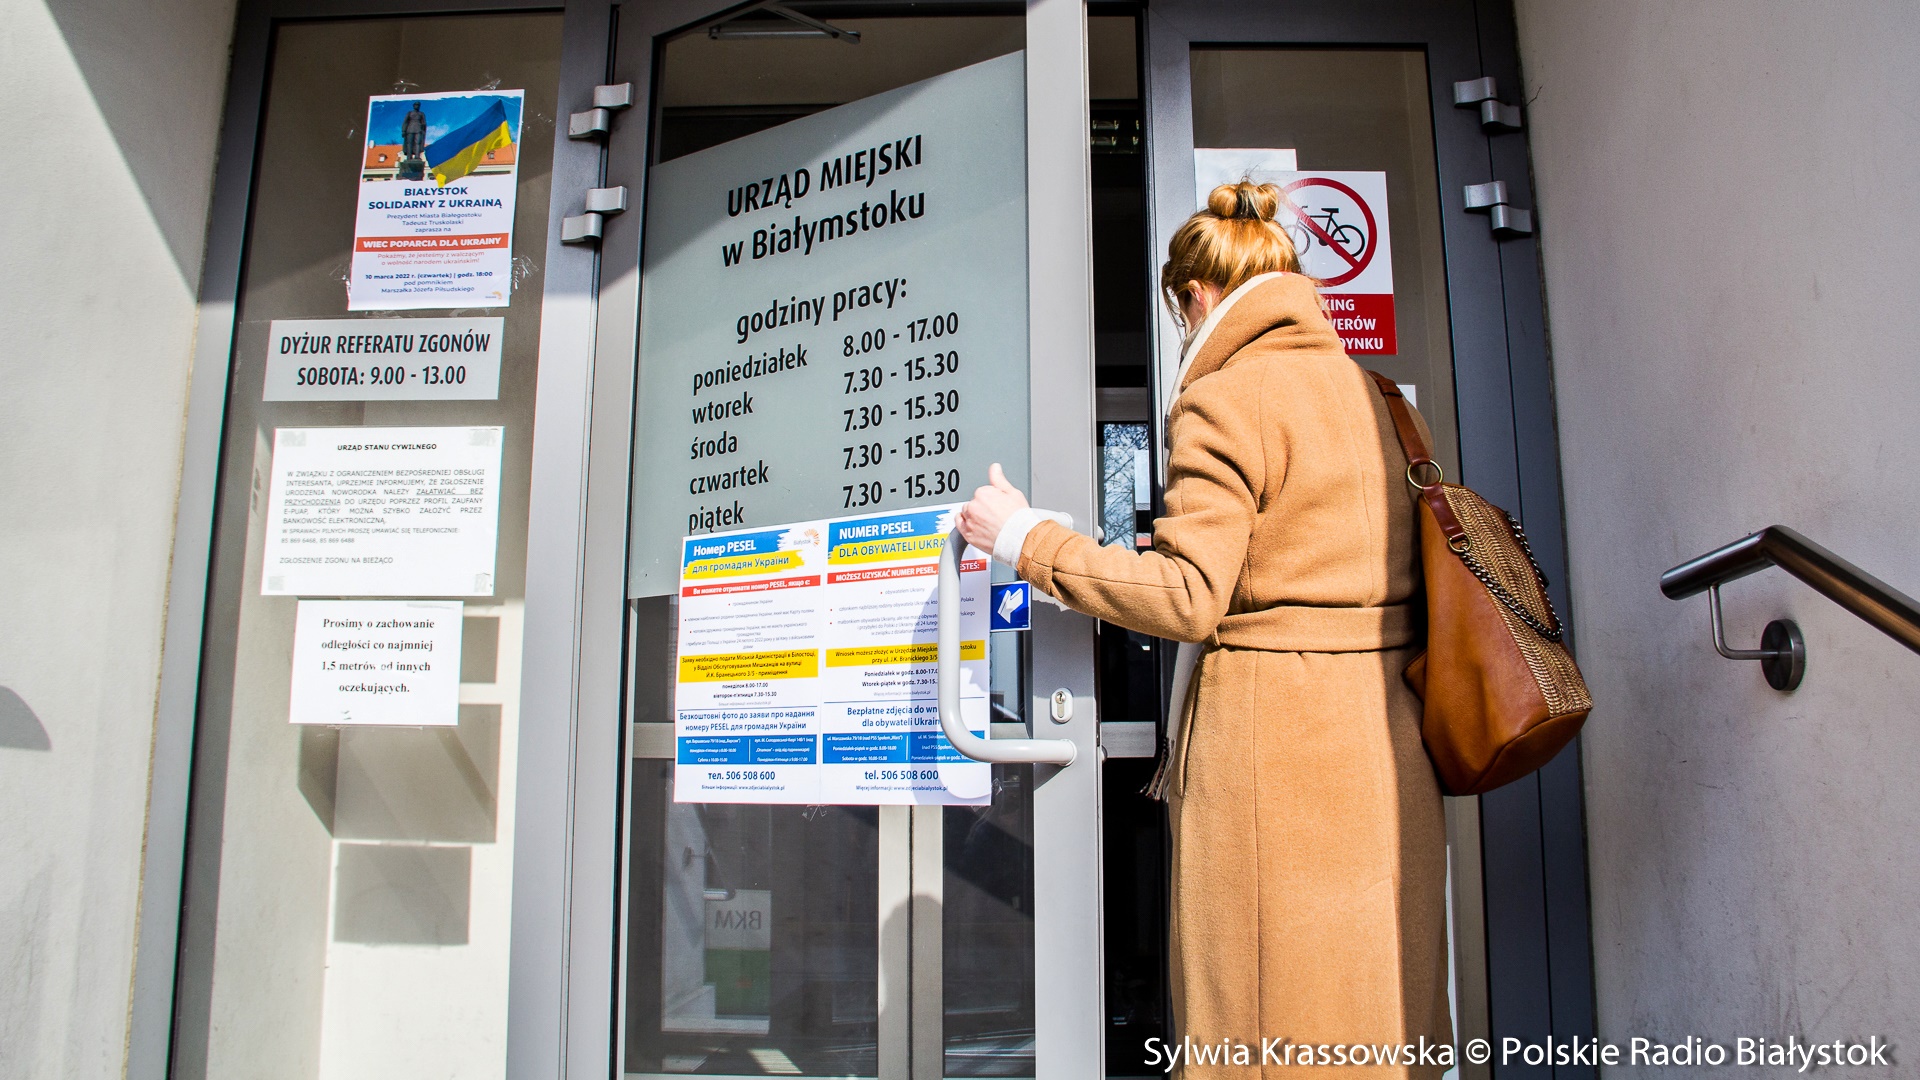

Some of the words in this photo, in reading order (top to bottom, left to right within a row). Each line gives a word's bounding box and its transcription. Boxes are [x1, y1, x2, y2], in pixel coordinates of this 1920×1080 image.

[727, 167, 810, 218] URZĄD
[820, 134, 923, 191] MIEJSKI
[404, 187, 468, 196] BIAŁYSTOK
[369, 200, 435, 209] SOLIDARNY
[449, 199, 502, 209] UKRAINĄ
[722, 239, 743, 267] w
[752, 189, 926, 261] Białymstoku
[390, 239, 436, 247] POPARCIA
[460, 237, 501, 245] UKRAINY
[736, 296, 826, 344] godziny
[833, 276, 907, 321] pracy:
[1321, 299, 1355, 311] KING
[1337, 315, 1376, 330] ERÓW
[280, 332, 331, 354] DYŻUR
[337, 335, 413, 354] REFERATU
[419, 329, 490, 353] ZGONÓW
[1346, 337, 1383, 350] YNKU
[693, 345, 808, 395] poniedziałek
[843, 329, 886, 358] 8.00
[907, 311, 960, 343] 17.00
[297, 367, 365, 386] SOBOTA:
[371, 366, 405, 384] 9.00
[423, 365, 466, 384] 13.00
[692, 392, 753, 424] wtorek
[844, 367, 883, 394] 7.30
[905, 350, 960, 382] 15.30
[690, 432, 738, 460] środa
[844, 405, 883, 432] 7.30
[905, 389, 960, 420] 15.30
[689, 460, 769, 495] czwartek
[843, 442, 882, 471] 7.30
[905, 428, 960, 460] 15.30
[296, 470, 327, 478] ZWIĄZKU
[396, 468, 451, 476] BEZPOŚREDNIEJ
[376, 479, 425, 487] INFORMUJEMY,
[428, 477, 437, 485] ŻE
[384, 487, 409, 495] NALEŻY
[416, 487, 456, 495] ZAŁATWIAĆ
[358, 498, 386, 506] URZĘDU
[688, 502, 744, 535] piątek
[842, 482, 882, 509] 7.30
[904, 469, 961, 499] 15.30
[283, 516, 326, 524] BANKOWOŚĆ
[840, 525, 879, 539] NUMER
[881, 521, 914, 535] PESEL
[694, 545, 725, 556] Номер
[727, 540, 756, 552] PESEL
[840, 548, 858, 558] DLA
[861, 541, 916, 556] OBYWATELI
[919, 538, 945, 551] UKRA
[363, 556, 393, 564] BIEŻĄCO
[692, 565, 708, 574] для
[710, 560, 752, 571] громадян
[755, 556, 789, 568] України
[836, 572, 861, 581] MOŻESZ
[862, 569, 890, 579] UZYSKAĆ
[891, 568, 914, 577] NUMER
[916, 566, 936, 575] PESEL,
[323, 619, 363, 630] Prosimy
[375, 619, 434, 628] zachowanie
[321, 640, 370, 650] odległości
[388, 641, 433, 651] najmniej
[339, 662, 375, 671] metrów
[381, 662, 393, 670] od
[396, 662, 431, 673] innych
[339, 683, 410, 694] oczekujących.
[680, 712, 720, 720] Безкоштовні
[722, 712, 738, 720] фото
[848, 707, 884, 716] Bezpłatne
[886, 706, 912, 716] zdjęcia
[686, 723, 709, 732] номеру
[711, 721, 729, 730] PESEL
[731, 723, 743, 731] для
[744, 722, 778, 731] громадян
[779, 720, 806, 730] України
[862, 719, 873, 727] dla
[875, 718, 913, 728] obywateli
[914, 717, 940, 726] Ukrain
[726, 771, 740, 779] 506
[743, 771, 758, 779] 508
[760, 771, 775, 779] 600
[865, 770, 879, 779] tel.
[881, 771, 897, 779] 506
[901, 771, 917, 779] 508
[920, 771, 939, 779] 600
